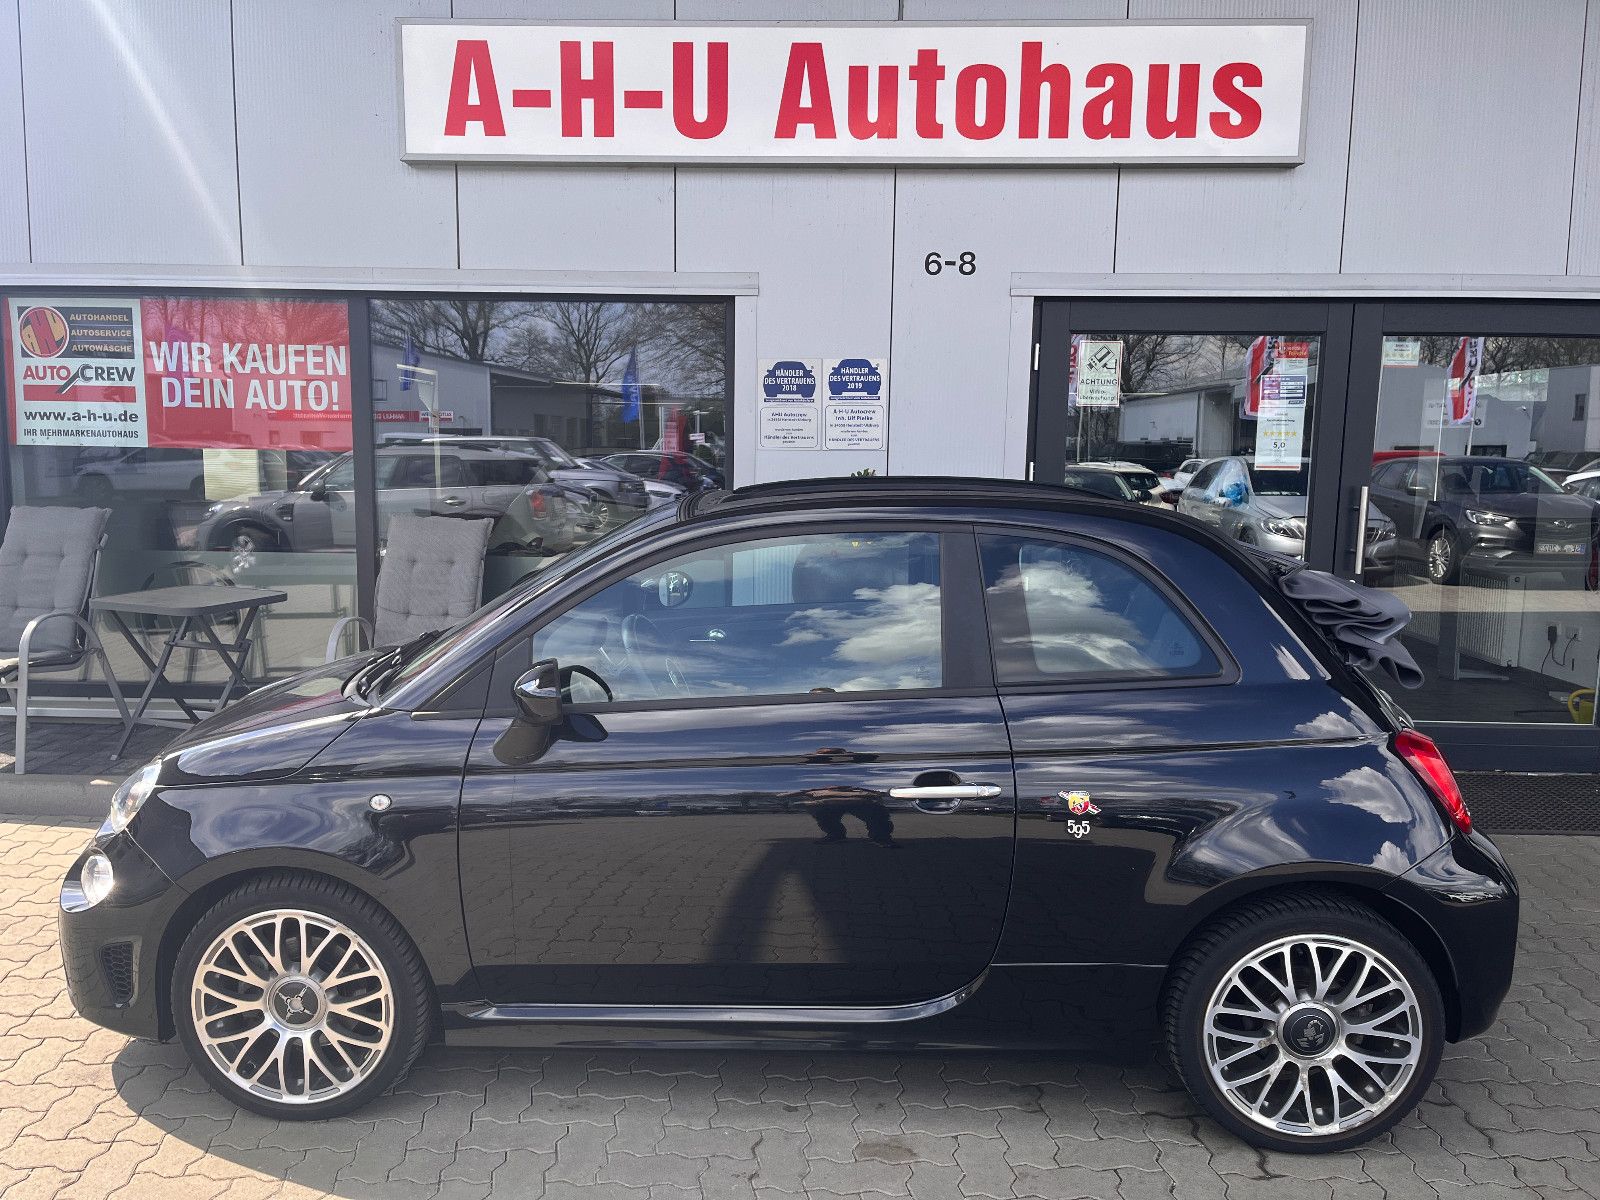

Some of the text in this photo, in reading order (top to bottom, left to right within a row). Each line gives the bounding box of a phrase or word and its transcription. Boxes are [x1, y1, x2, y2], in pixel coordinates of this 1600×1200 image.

[445, 40, 1262, 140] A-H-U Autohaus
[925, 252, 976, 275] 6-8
[69, 314, 129, 322] AUTOHANDEL
[70, 329, 132, 337] AUTOSERVICE
[71, 343, 132, 352] AUTOWÄSCHE
[149, 341, 347, 376] WIR KAUFEN
[23, 364, 135, 382] AUTO CREW
[775, 368, 804, 377] HÄNDLER
[764, 377, 815, 385] DES VERTRAUENS
[782, 384, 797, 392] 2018
[161, 377, 340, 411] DEIN AUTO!
[24, 410, 139, 423] www.a-h-u.de
[24, 428, 139, 438] IHR MEHRMARKENAUTOHAUS
[1272, 441, 1286, 449] 5,0
[1067, 819, 1091, 839] 595
